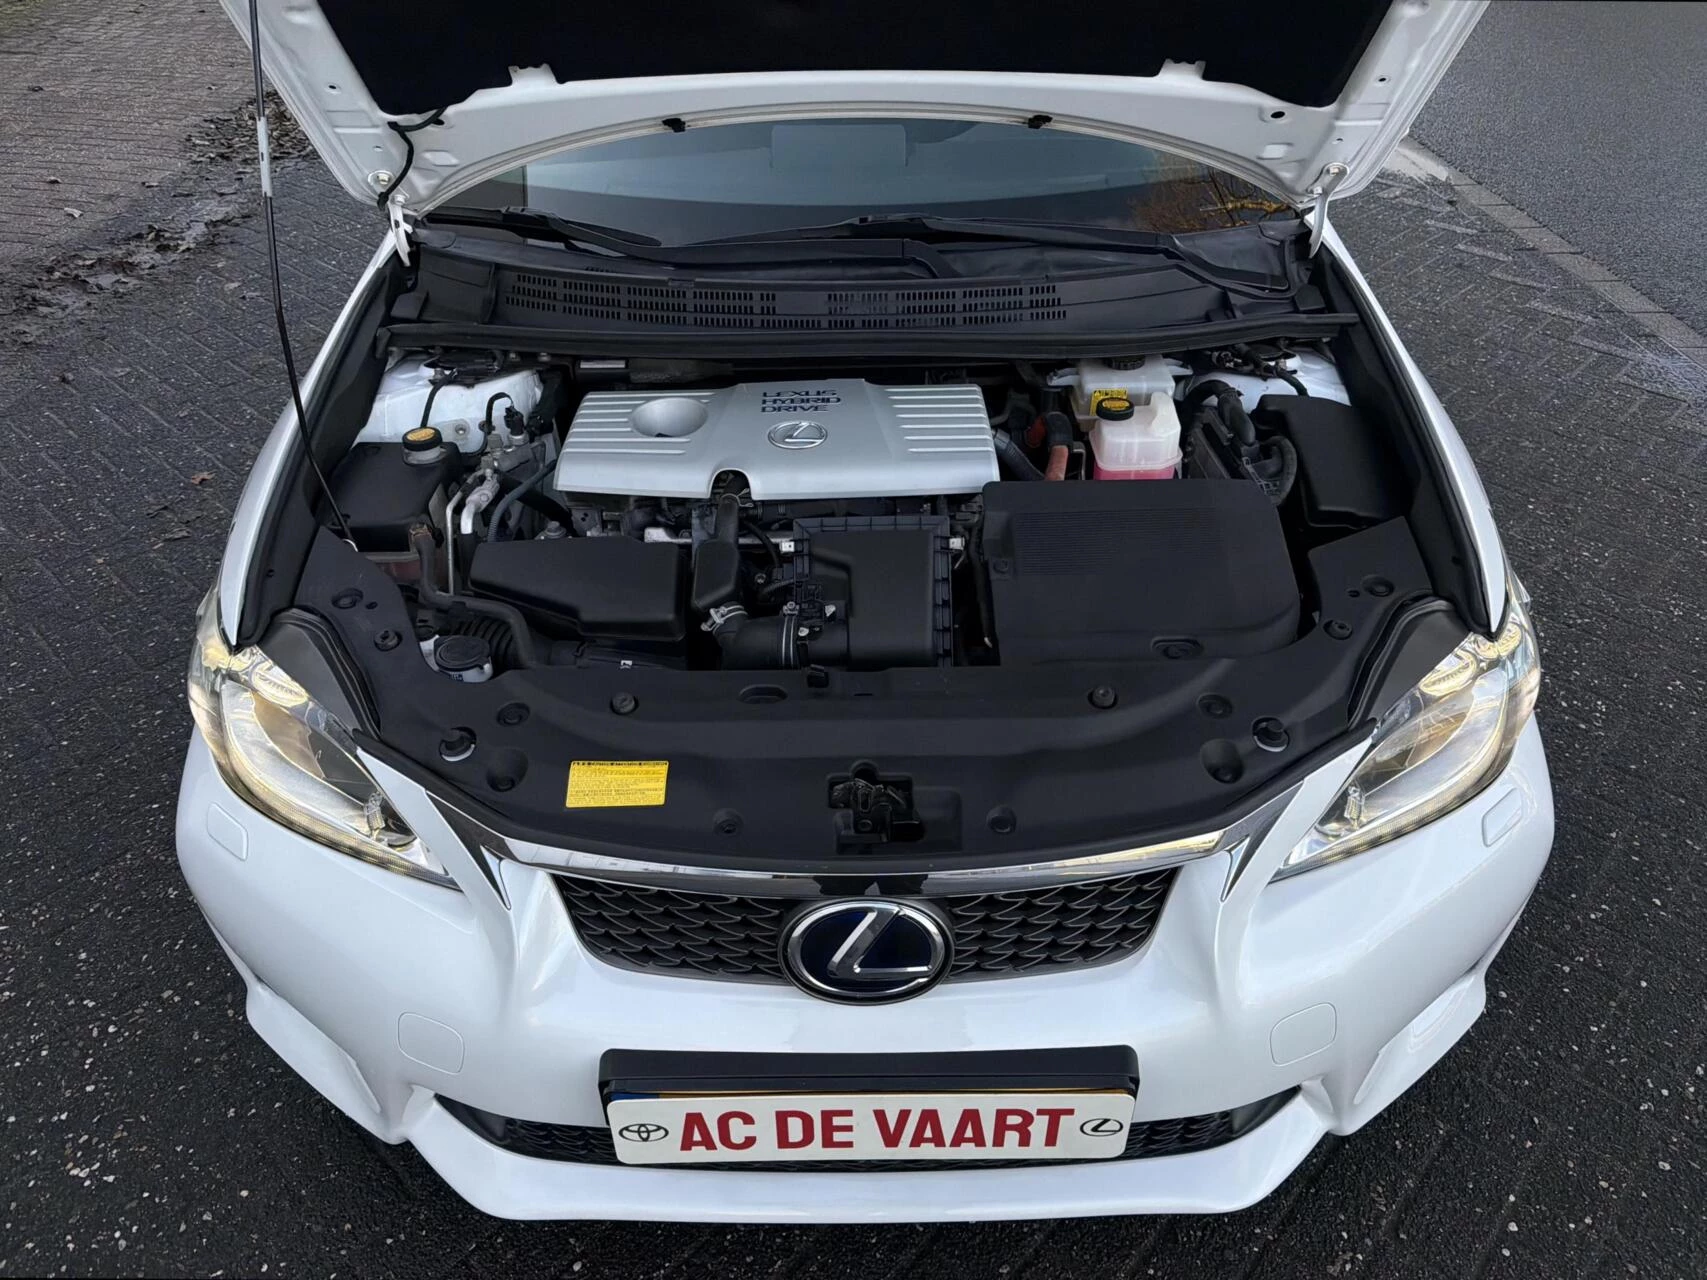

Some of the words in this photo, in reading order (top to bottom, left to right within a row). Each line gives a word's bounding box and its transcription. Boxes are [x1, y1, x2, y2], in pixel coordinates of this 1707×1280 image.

[762, 389, 838, 397] LEXUS
[761, 397, 841, 405] HYBRID
[760, 404, 829, 413] DRIVE
[680, 1111, 756, 1152] AC
[776, 1109, 854, 1149] DE
[873, 1108, 1075, 1148] VAART
